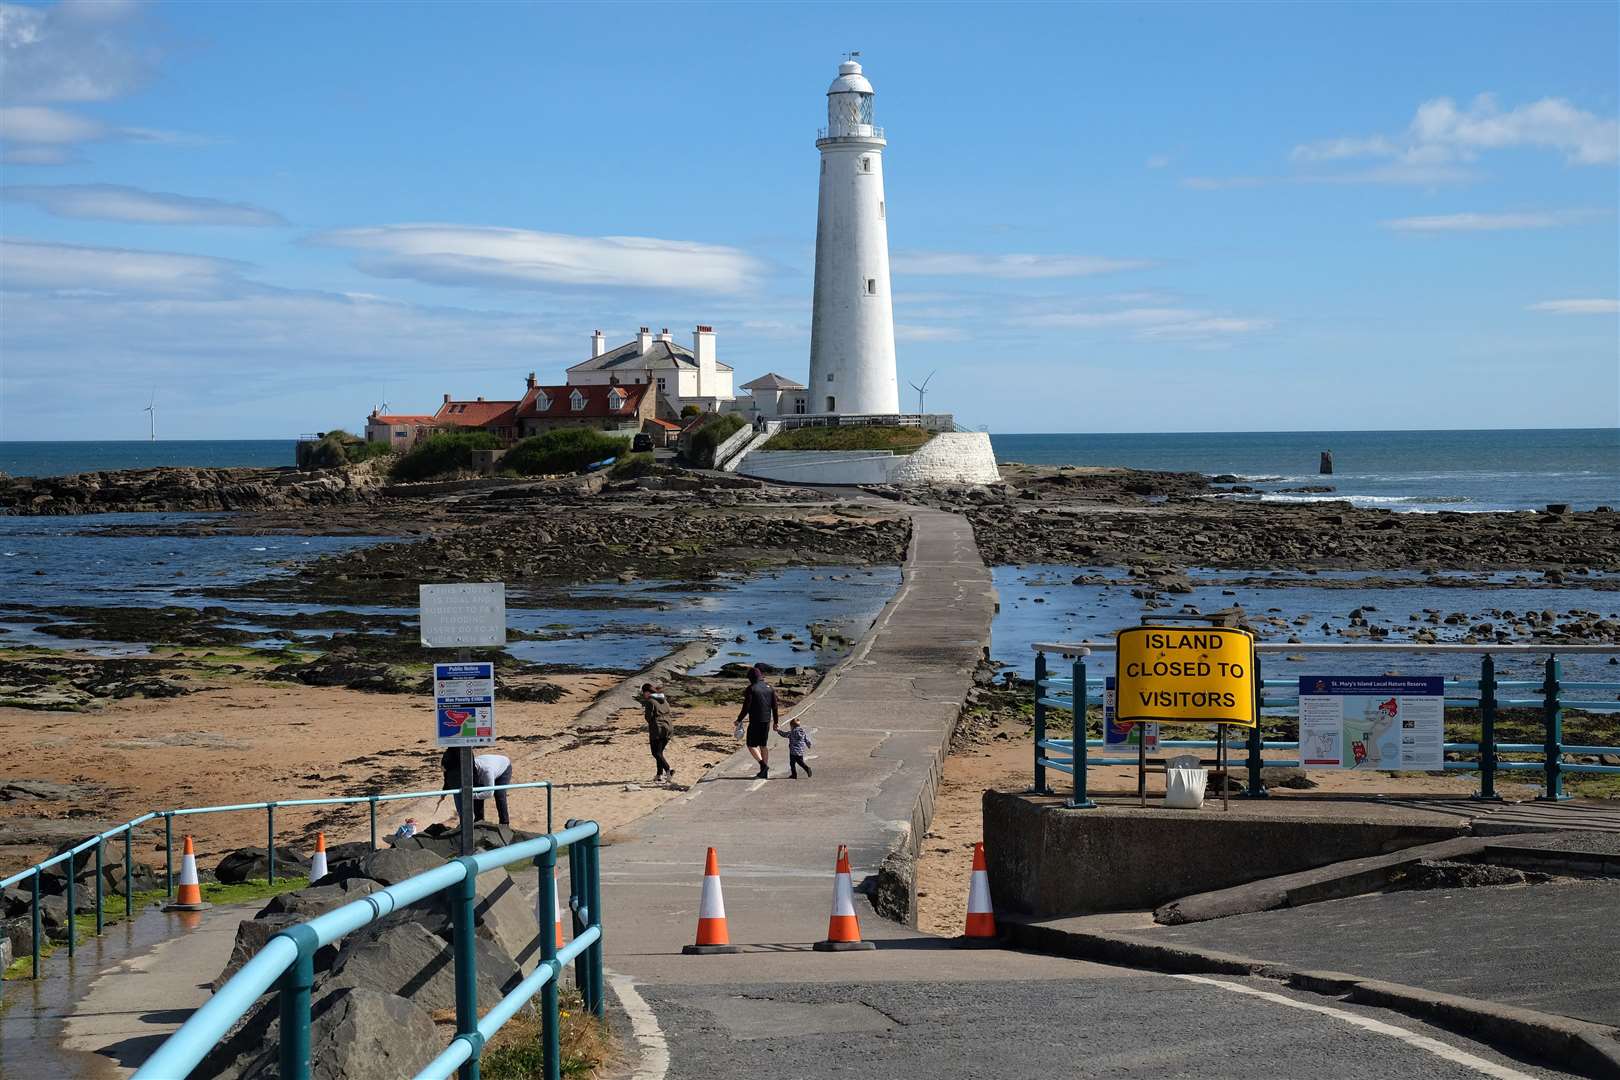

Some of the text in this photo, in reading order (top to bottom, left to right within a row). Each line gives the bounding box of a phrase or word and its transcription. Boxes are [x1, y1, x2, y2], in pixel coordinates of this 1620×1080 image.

[1145, 634, 1223, 649] ISLAND
[1126, 661, 1244, 678] CLOSED TO
[1340, 680, 1356, 688] Mary's
[1139, 691, 1236, 708] VISITORS
